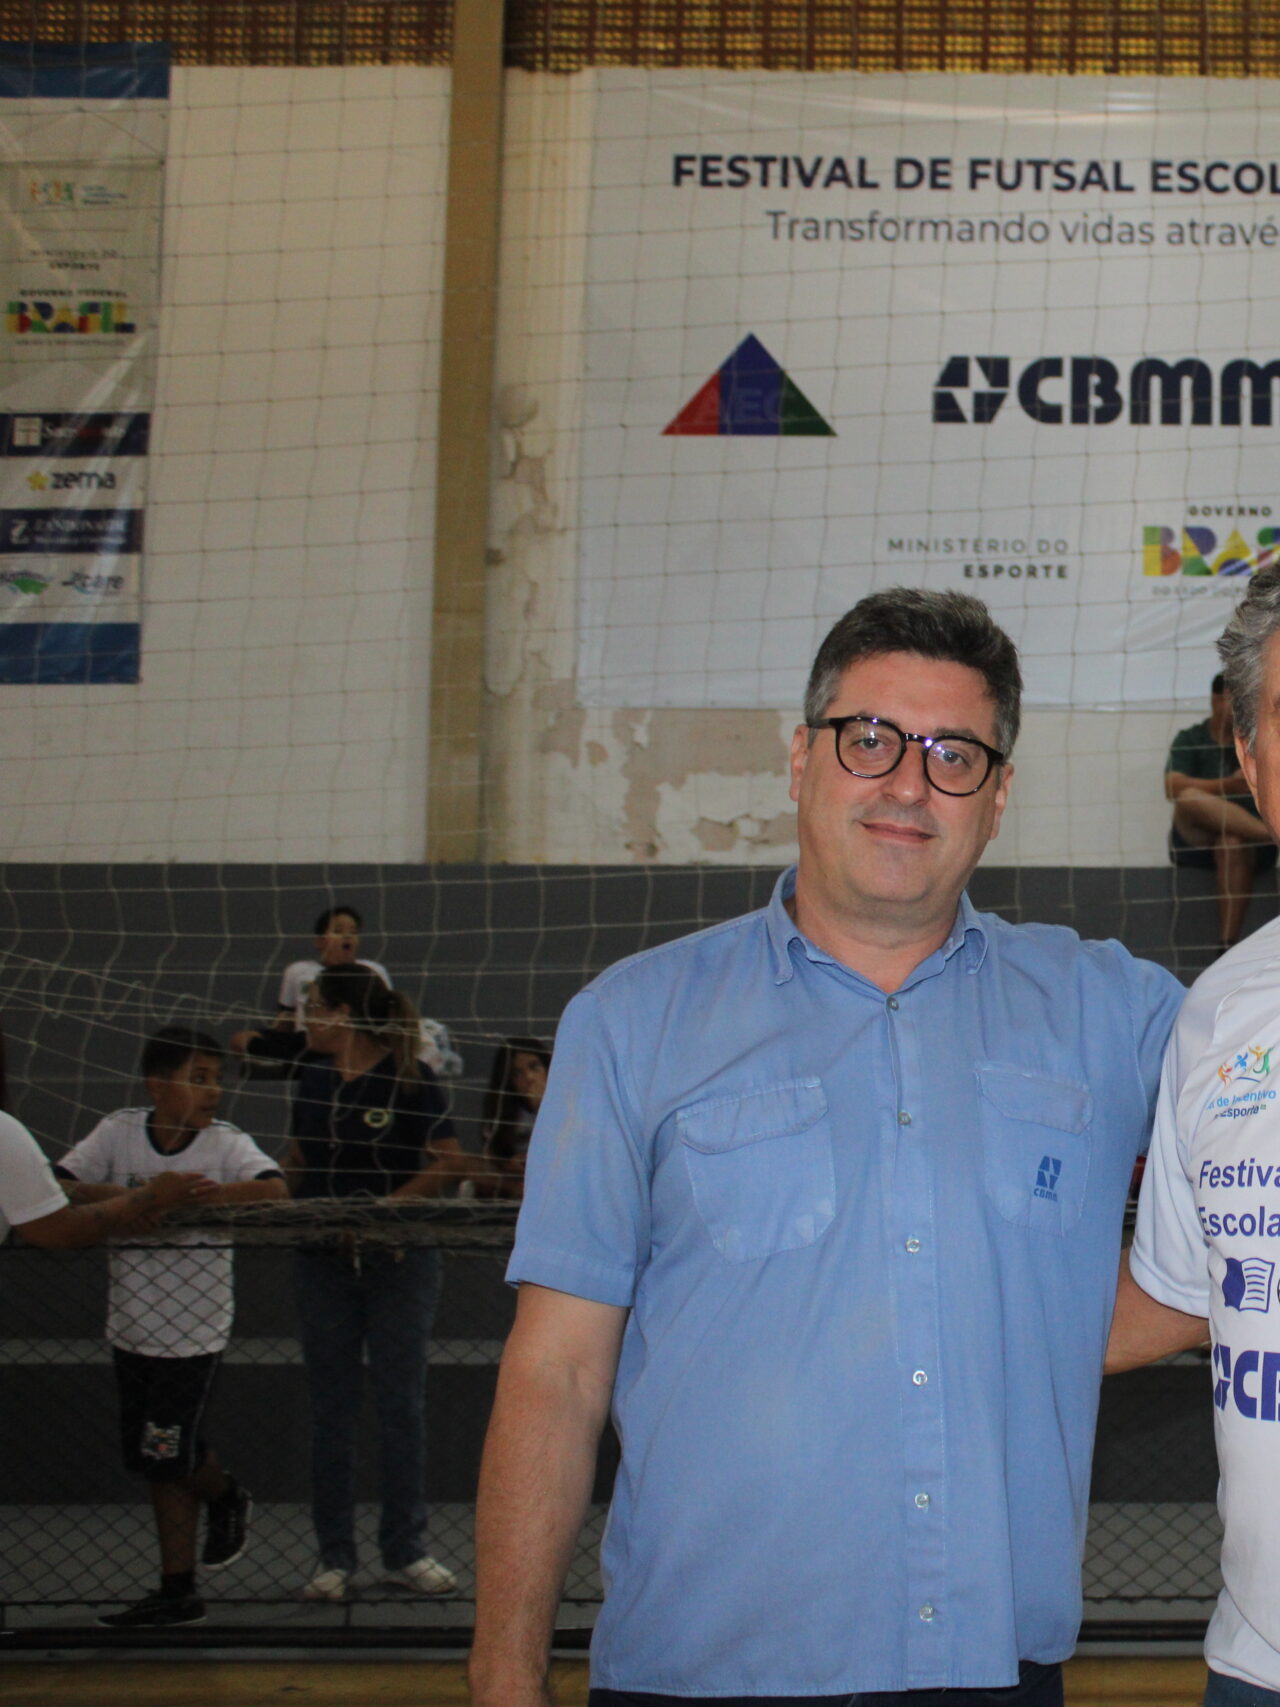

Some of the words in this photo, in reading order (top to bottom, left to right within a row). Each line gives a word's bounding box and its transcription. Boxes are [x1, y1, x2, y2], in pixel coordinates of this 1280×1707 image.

[672, 154, 879, 190] FESTIVAL
[893, 157, 952, 191] DE
[968, 158, 1136, 193] FUTSAL
[765, 211, 1050, 244] Transformando
[1060, 213, 1155, 246] vidas
[5, 301, 136, 334] BRASIL
[51, 471, 117, 490] zema
[1188, 505, 1272, 518] GOVERNO
[1037, 538, 1069, 556] DO
[962, 564, 1069, 579] ESPORTE
